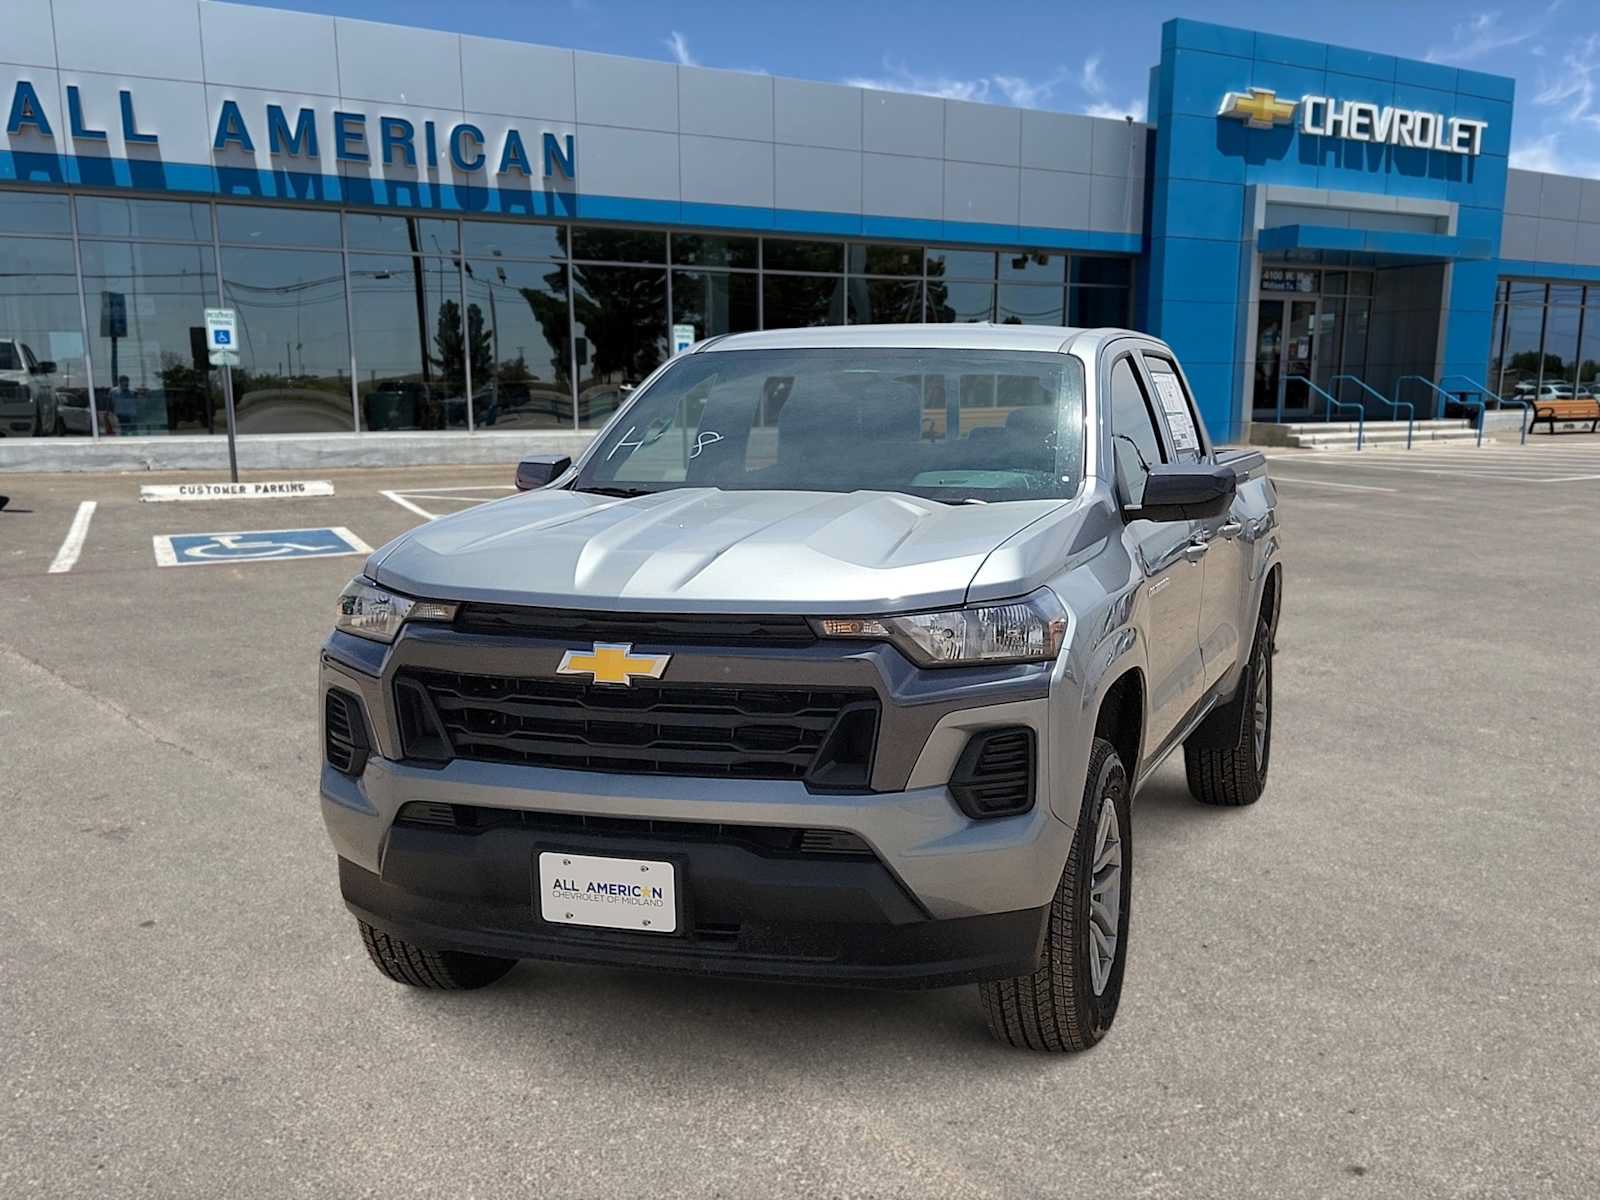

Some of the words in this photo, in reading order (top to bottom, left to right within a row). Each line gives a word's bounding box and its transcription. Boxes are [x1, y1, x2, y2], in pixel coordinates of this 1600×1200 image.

[6, 80, 158, 144] ALL
[213, 99, 576, 179] AMERICAN
[1301, 94, 1488, 156] CHEVROLET
[179, 485, 246, 496] CUSTOMER
[254, 483, 305, 494] PARKING
[552, 878, 580, 892] ALL
[552, 890, 605, 903] CHEVROLET
[606, 895, 621, 904] OF
[621, 897, 664, 908] MIDLAND
